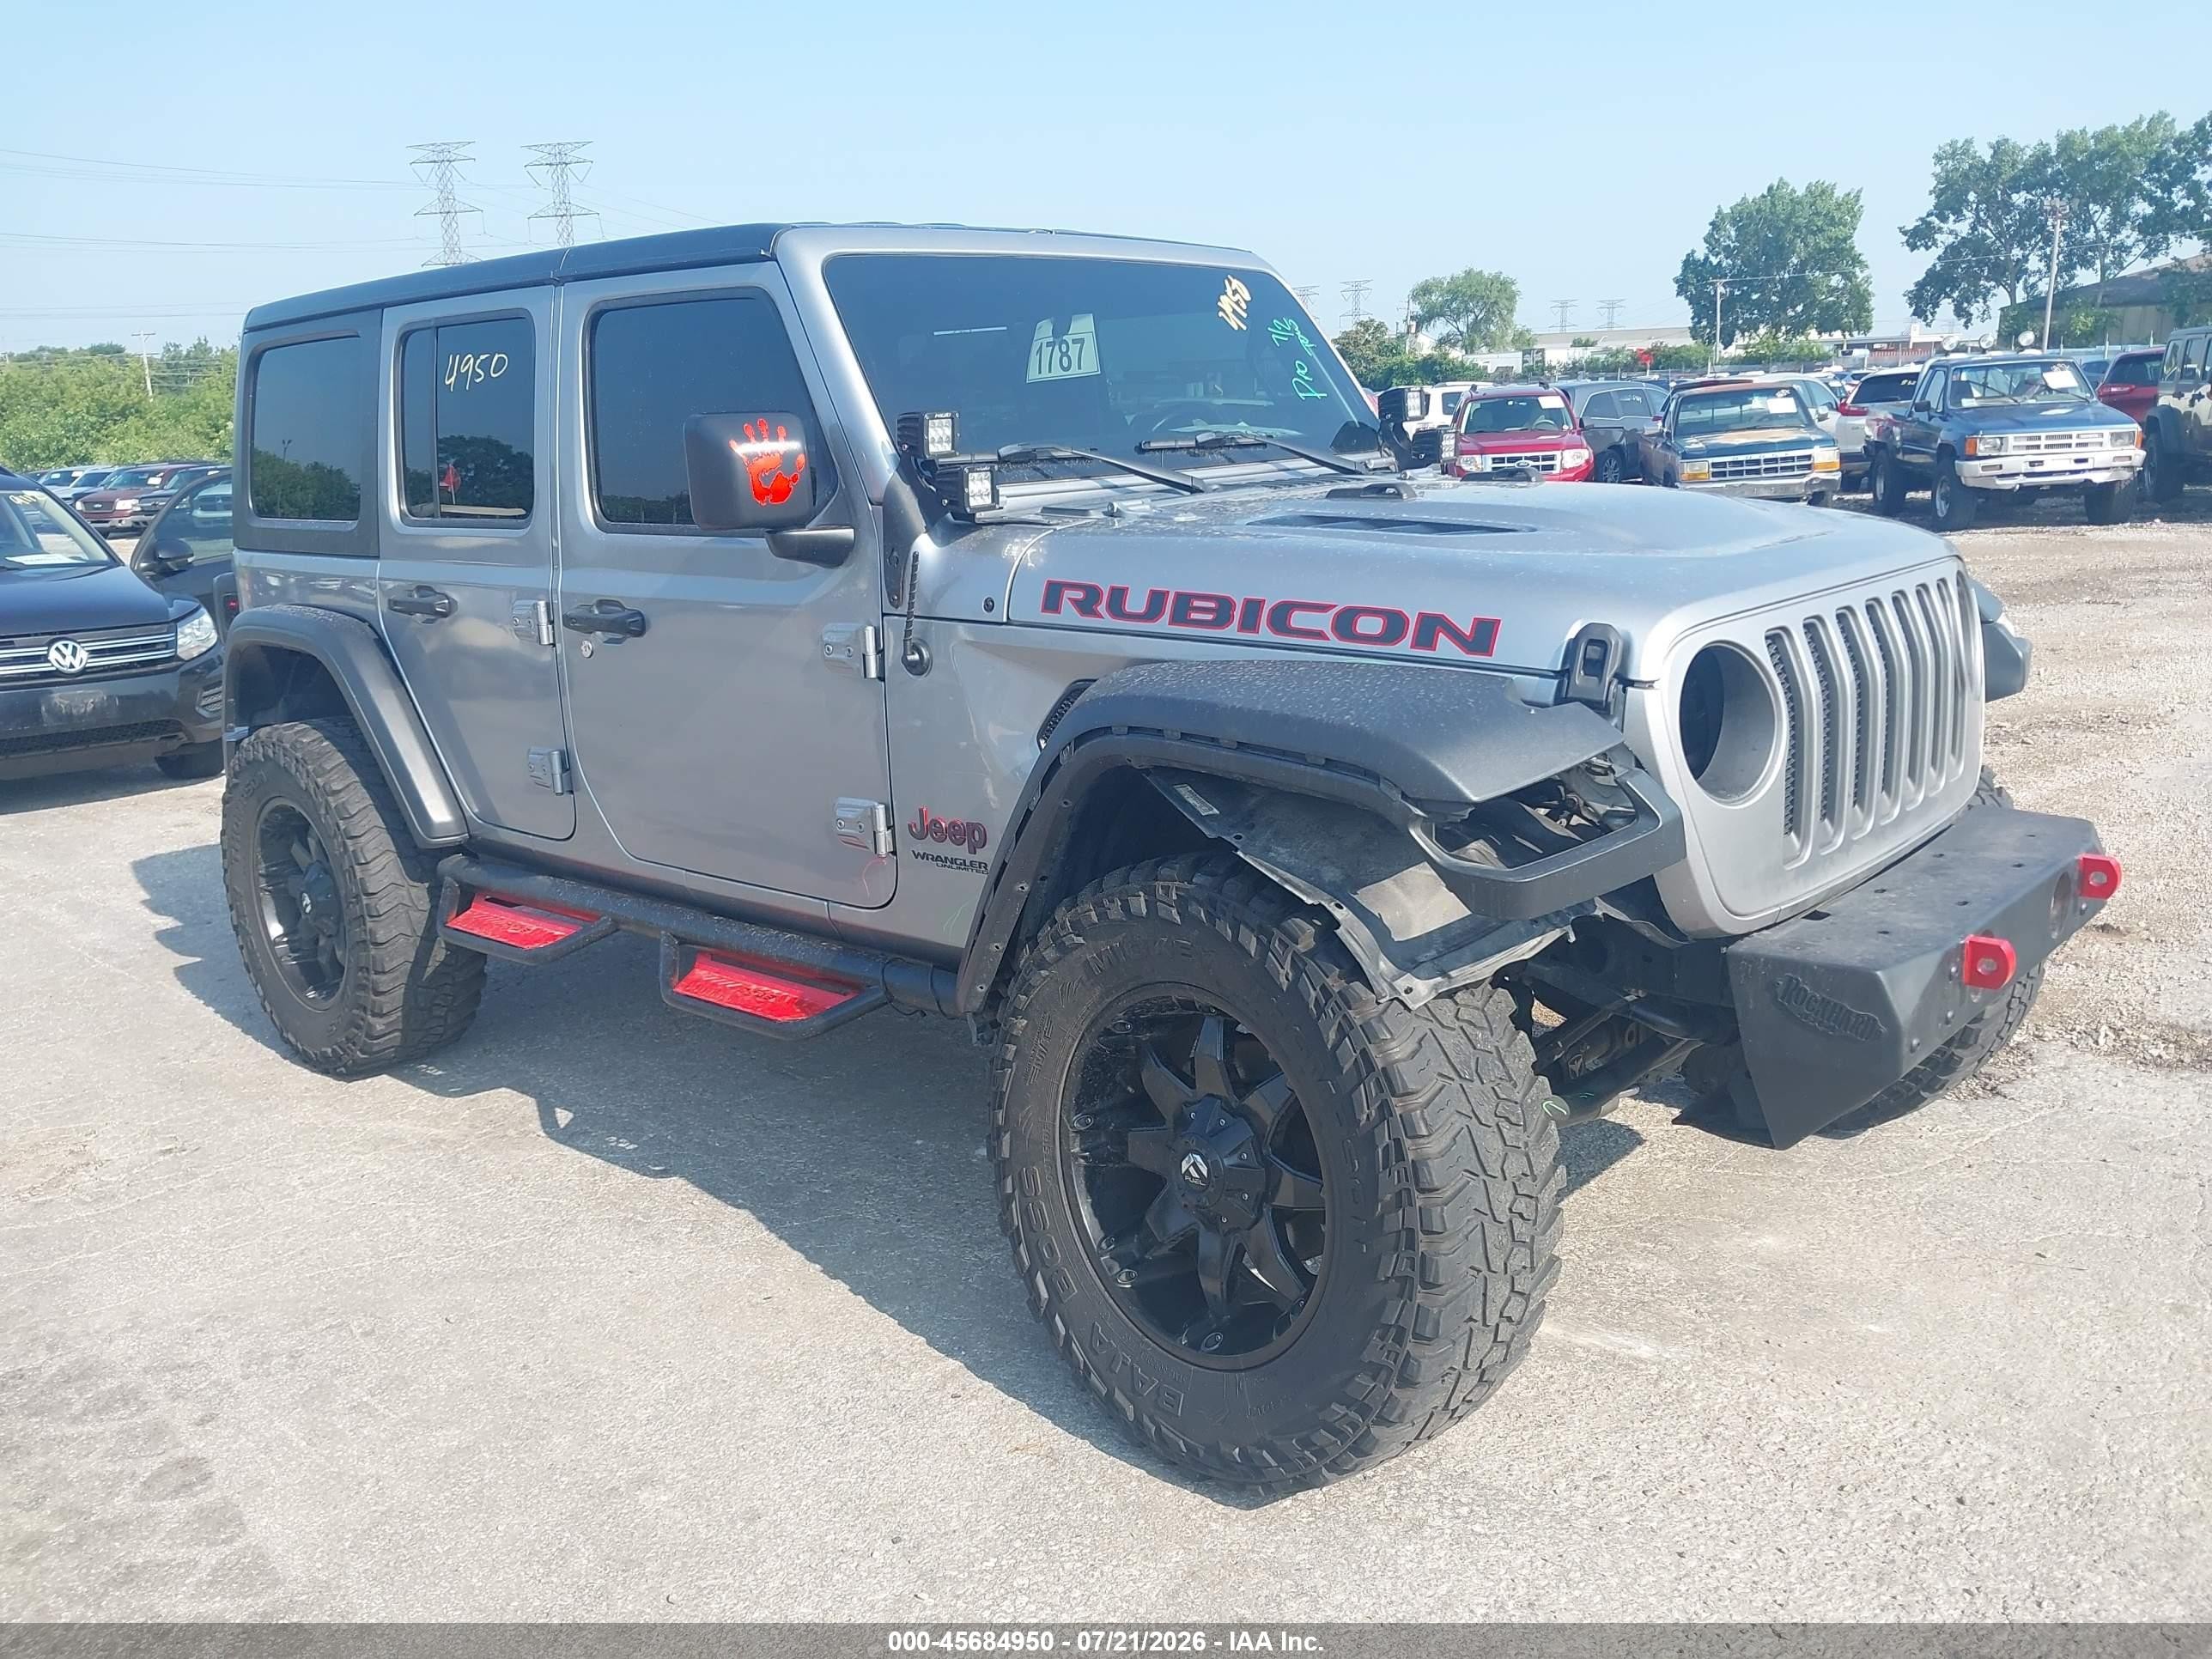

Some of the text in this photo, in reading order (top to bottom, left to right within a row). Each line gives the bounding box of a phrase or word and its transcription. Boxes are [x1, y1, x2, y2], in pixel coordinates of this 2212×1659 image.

[445, 353, 508, 392] 4950
[1036, 337, 1085, 374] 1787
[1041, 579, 1502, 657] RUBICON
[908, 805, 988, 855] Jeep
[912, 849, 988, 871] WRANGLER
[936, 862, 989, 875] UNLIMITED
[1184, 1175, 1207, 1186] FUEL
[1019, 1165, 1079, 1304] BOSS
[1091, 1321, 1185, 1417] BAJA
